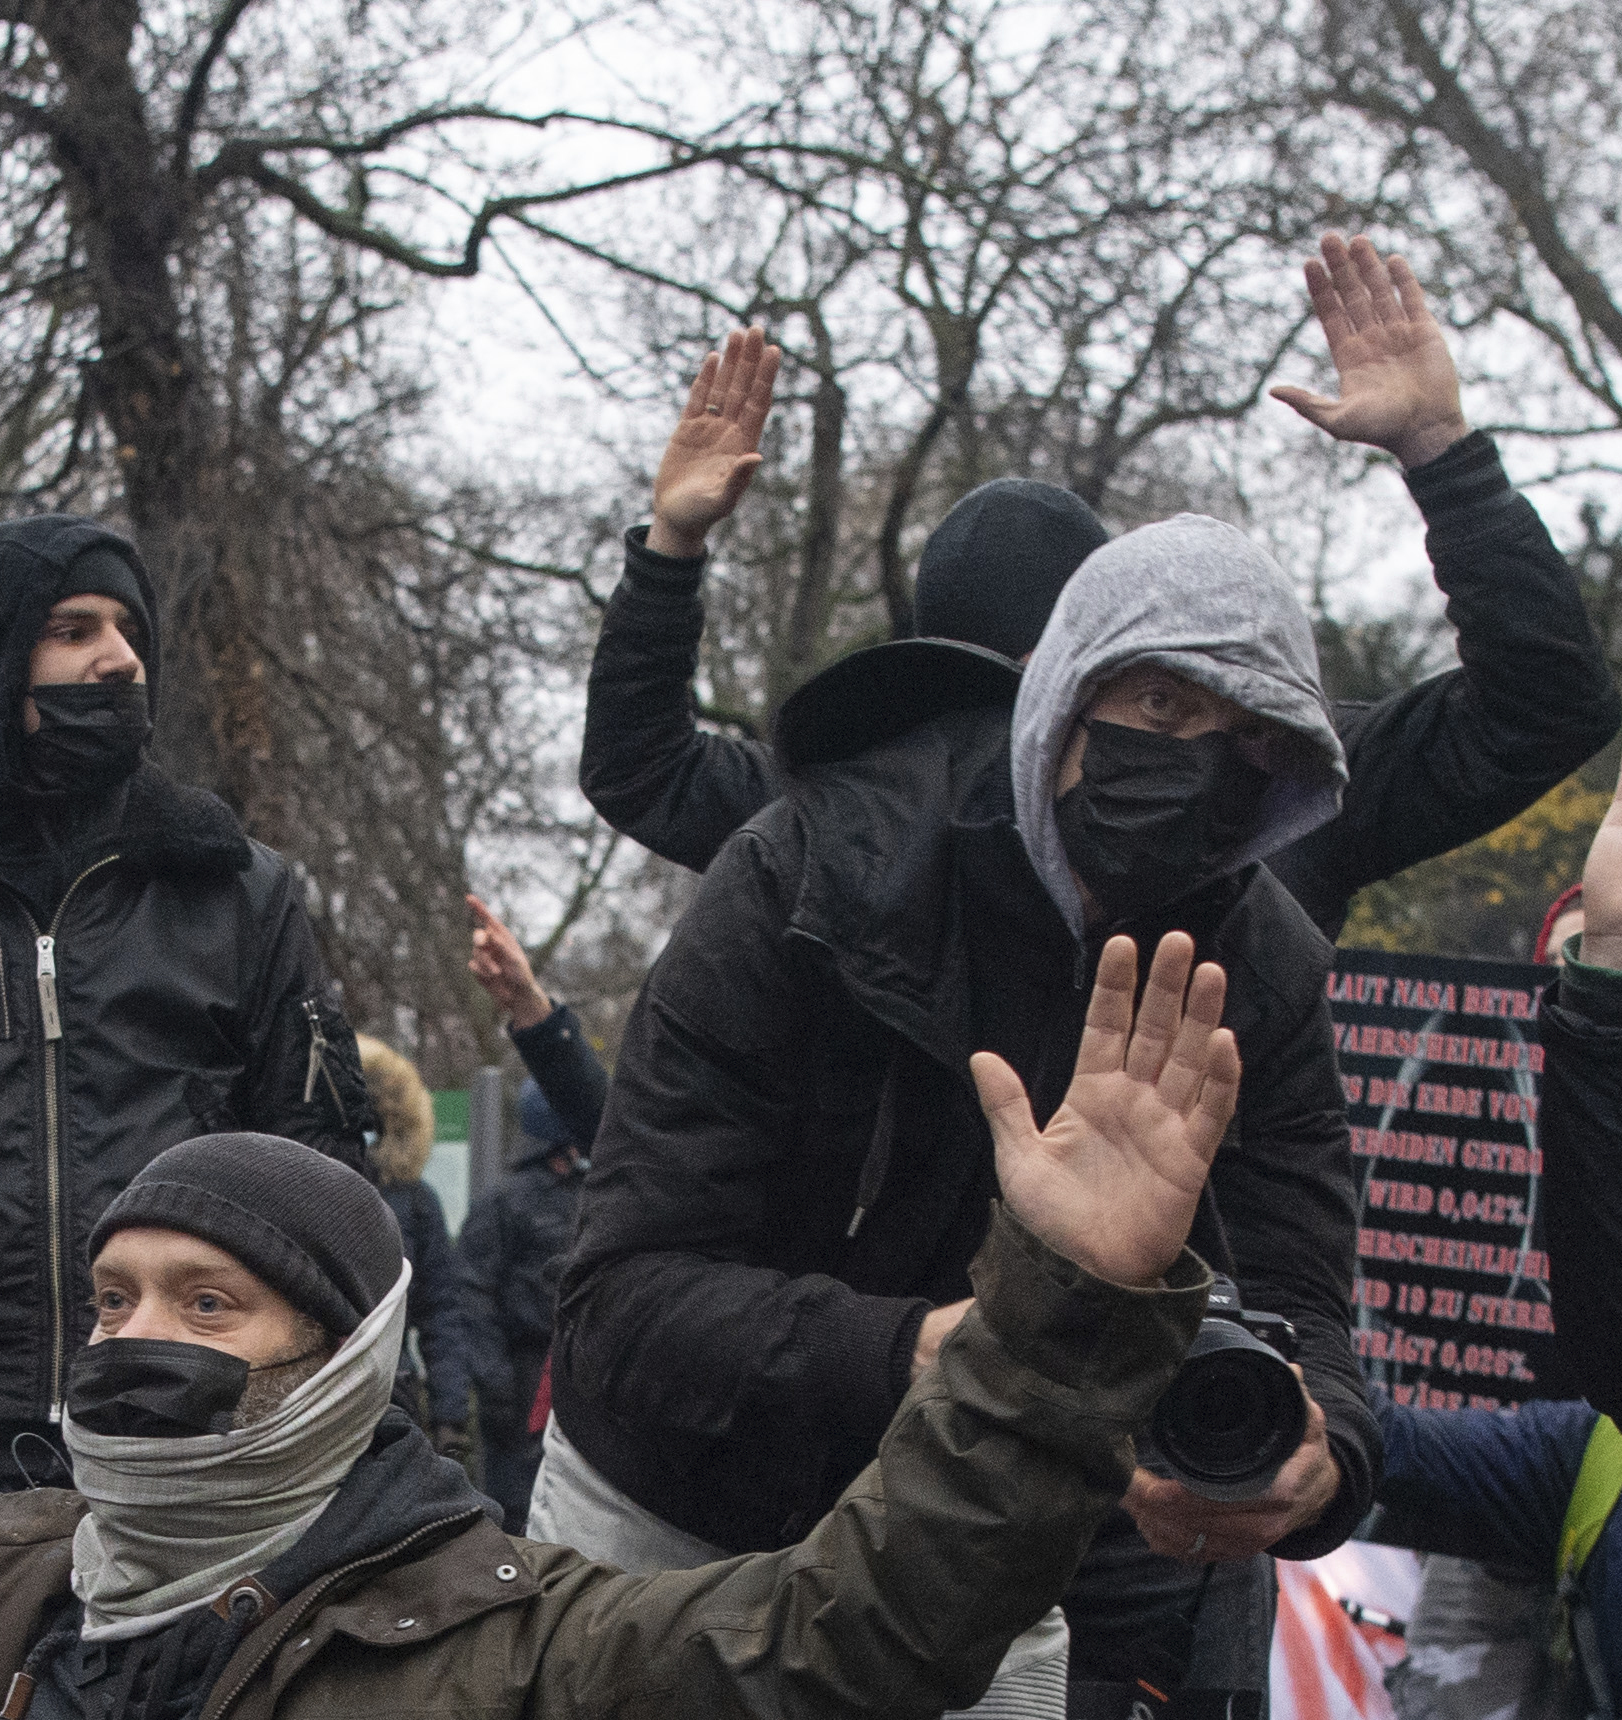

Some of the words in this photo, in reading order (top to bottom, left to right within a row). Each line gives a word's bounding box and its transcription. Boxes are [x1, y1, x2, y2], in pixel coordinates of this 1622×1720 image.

[1326, 972, 1389, 1005] LAUT
[1392, 977, 1456, 1013] NASA
[1416, 1082, 1483, 1118] ERDE
[1368, 1178, 1434, 1214] WIRD
[1428, 1288, 1464, 1321] ZU
